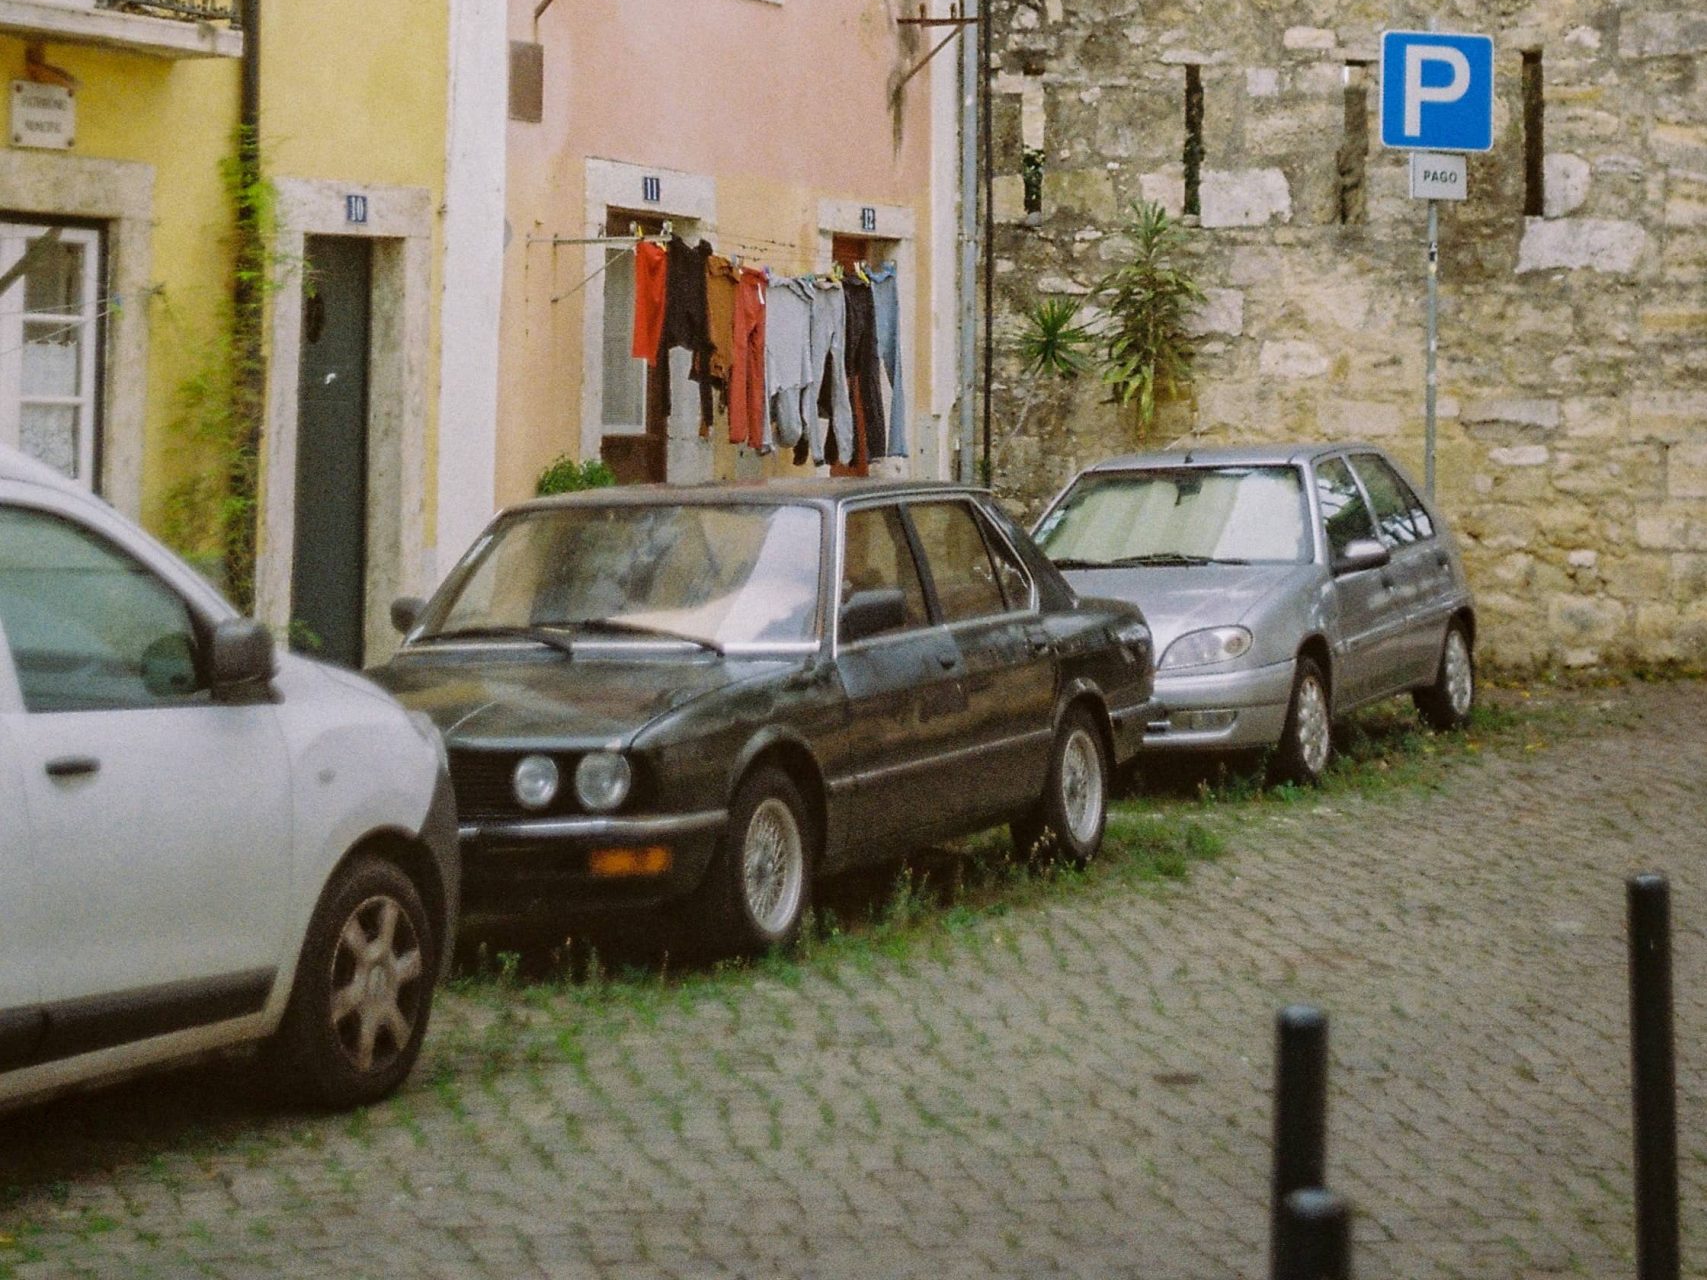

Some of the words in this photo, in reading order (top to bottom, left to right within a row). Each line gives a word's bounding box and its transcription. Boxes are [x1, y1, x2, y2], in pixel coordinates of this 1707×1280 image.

[1404, 44, 1470, 137] P
[1423, 170, 1458, 184] PAGO
[647, 178, 657, 200] 11
[352, 196, 364, 221] 10
